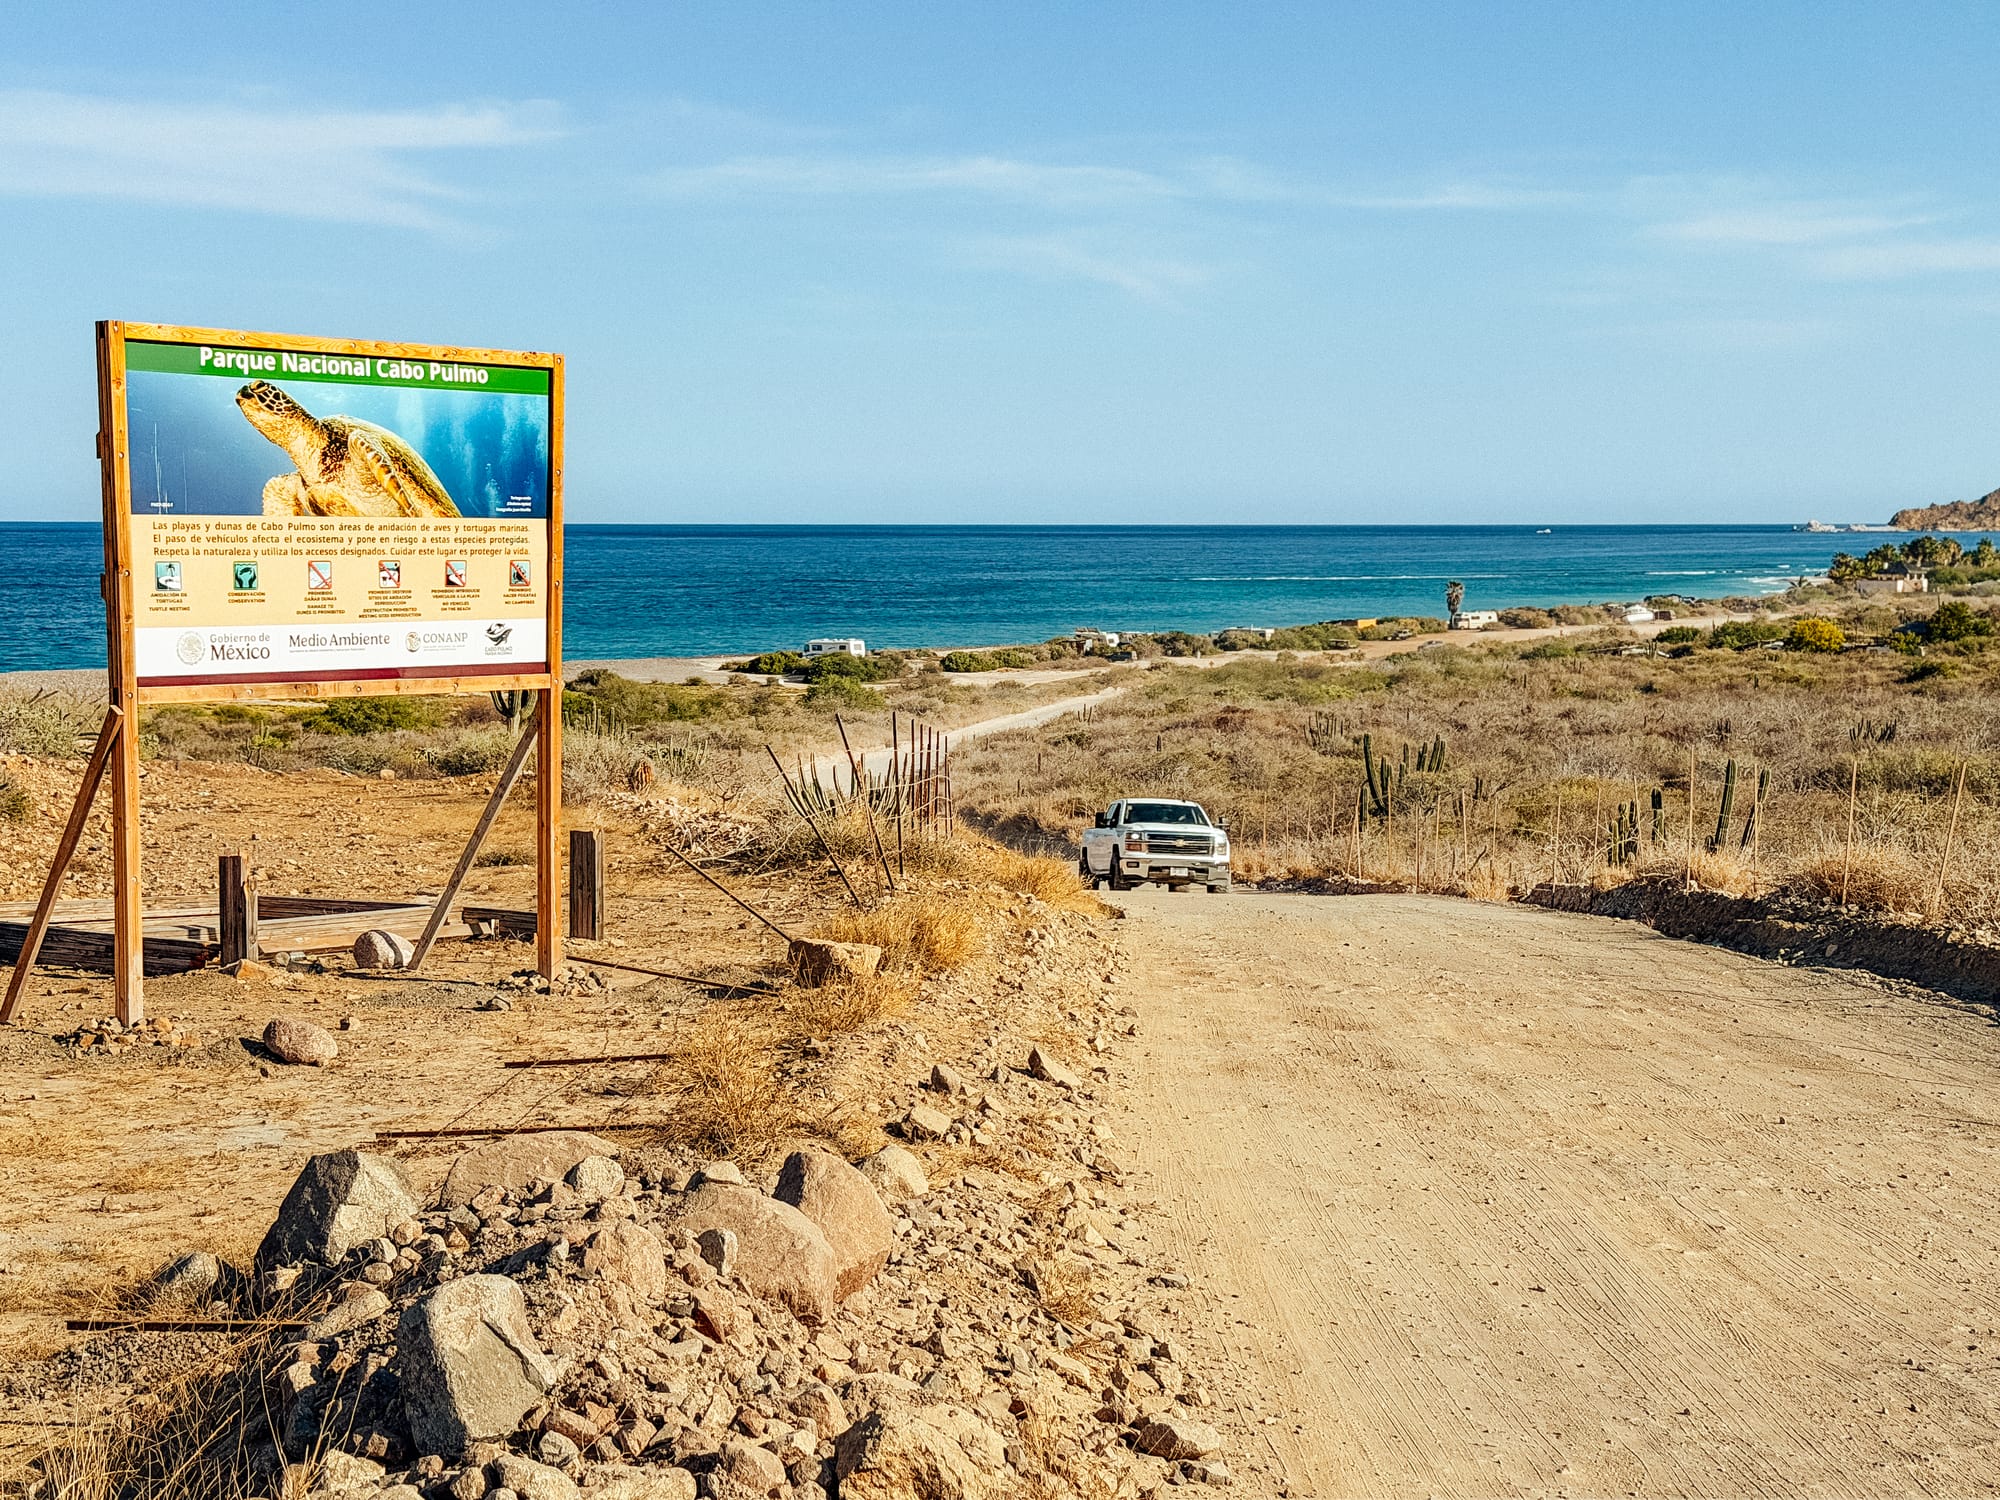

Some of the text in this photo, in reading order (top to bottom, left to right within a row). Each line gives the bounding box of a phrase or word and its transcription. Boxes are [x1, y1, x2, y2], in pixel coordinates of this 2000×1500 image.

[200, 347, 489, 384] Parque Nacional Cabo Pulmo
[152, 521, 168, 530] Las
[171, 521, 201, 533] playas
[204, 523, 211, 533] y
[214, 521, 242, 530] dunas
[245, 522, 257, 531] de
[260, 522, 283, 531] Cabo
[287, 522, 316, 531] Pulmo
[338, 523, 362, 531] áreas
[364, 522, 375, 531] de
[377, 523, 417, 531] anidación
[420, 523, 430, 532] de
[454, 525, 460, 534] y
[463, 524, 496, 534] tortugas
[153, 534, 161, 543] El
[165, 535, 186, 545] paso
[190, 534, 202, 543] de
[251, 534, 280, 543] afecta
[283, 534, 292, 543] el
[296, 534, 344, 543] ecosistema
[347, 536, 353, 546] y
[356, 536, 376, 546] pone
[393, 535, 418, 545] riesgo
[430, 536, 450, 544] estas
[453, 535, 487, 545] especies
[153, 547, 190, 558] Respeta
[192, 547, 201, 556] la
[203, 547, 251, 556] naturaleza
[253, 549, 259, 558] y
[261, 547, 288, 556] utiliza
[290, 547, 303, 556] los
[390, 547, 416, 556] Cuidar
[418, 548, 435, 556] este
[436, 547, 457, 558] lugar
[469, 548, 503, 557] proteger
[504, 547, 511, 555] la
[209, 632, 270, 644] Gobierno de
[289, 632, 390, 648] Medio Ambiente
[423, 632, 468, 644] CONANP
[210, 643, 270, 661] México
